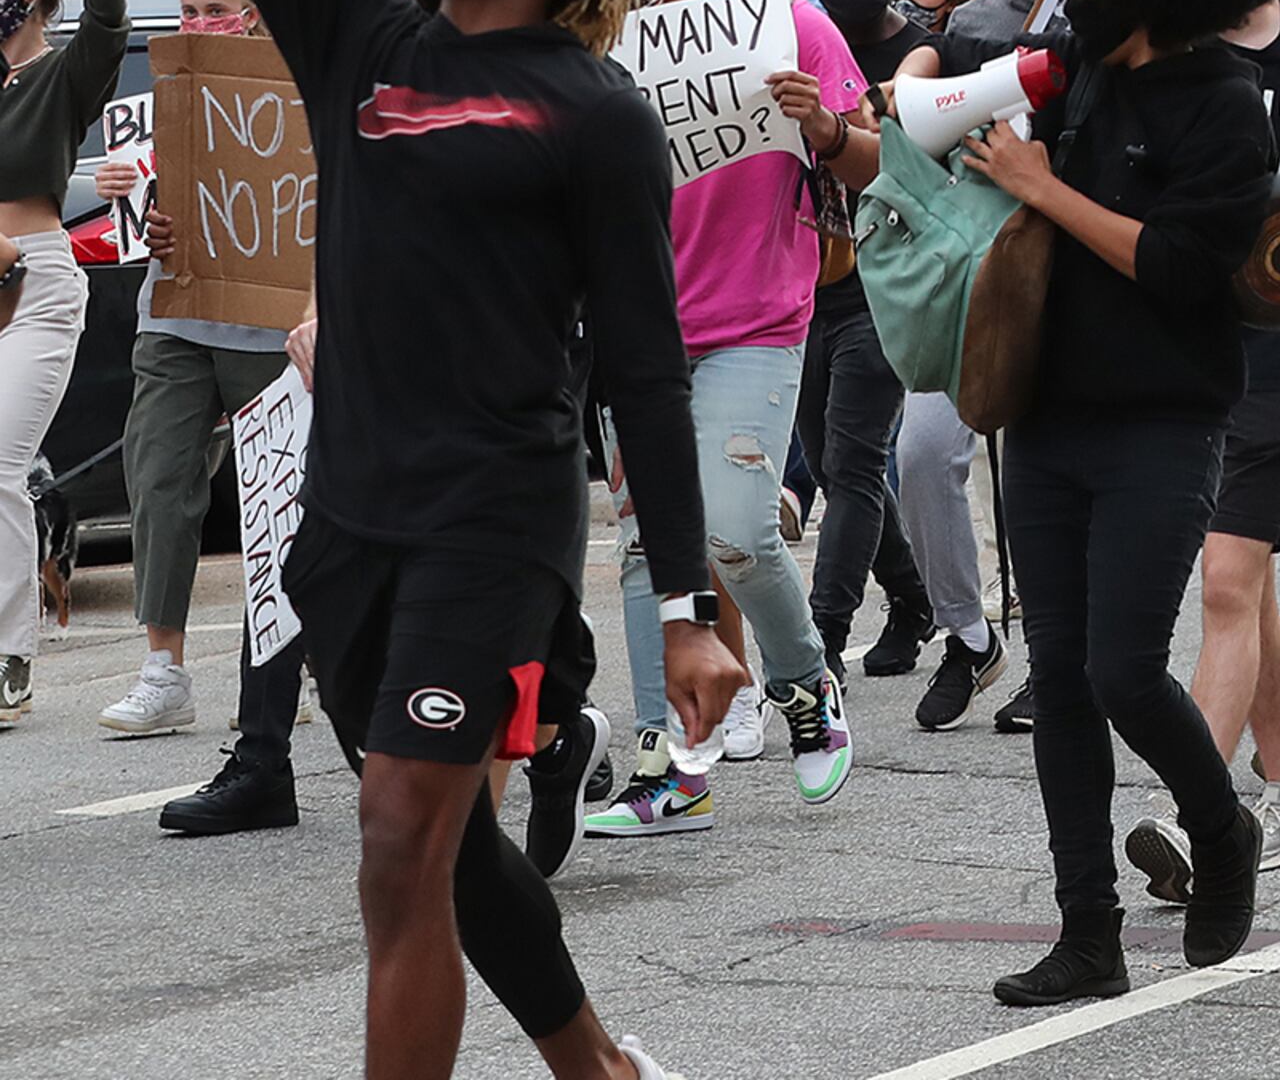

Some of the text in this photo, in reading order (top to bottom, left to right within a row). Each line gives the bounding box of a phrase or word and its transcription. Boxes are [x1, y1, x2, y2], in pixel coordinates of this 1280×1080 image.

[201, 85, 285, 158] NO
[198, 168, 261, 259] NO
[238, 396, 282, 656] RESISTANCE
